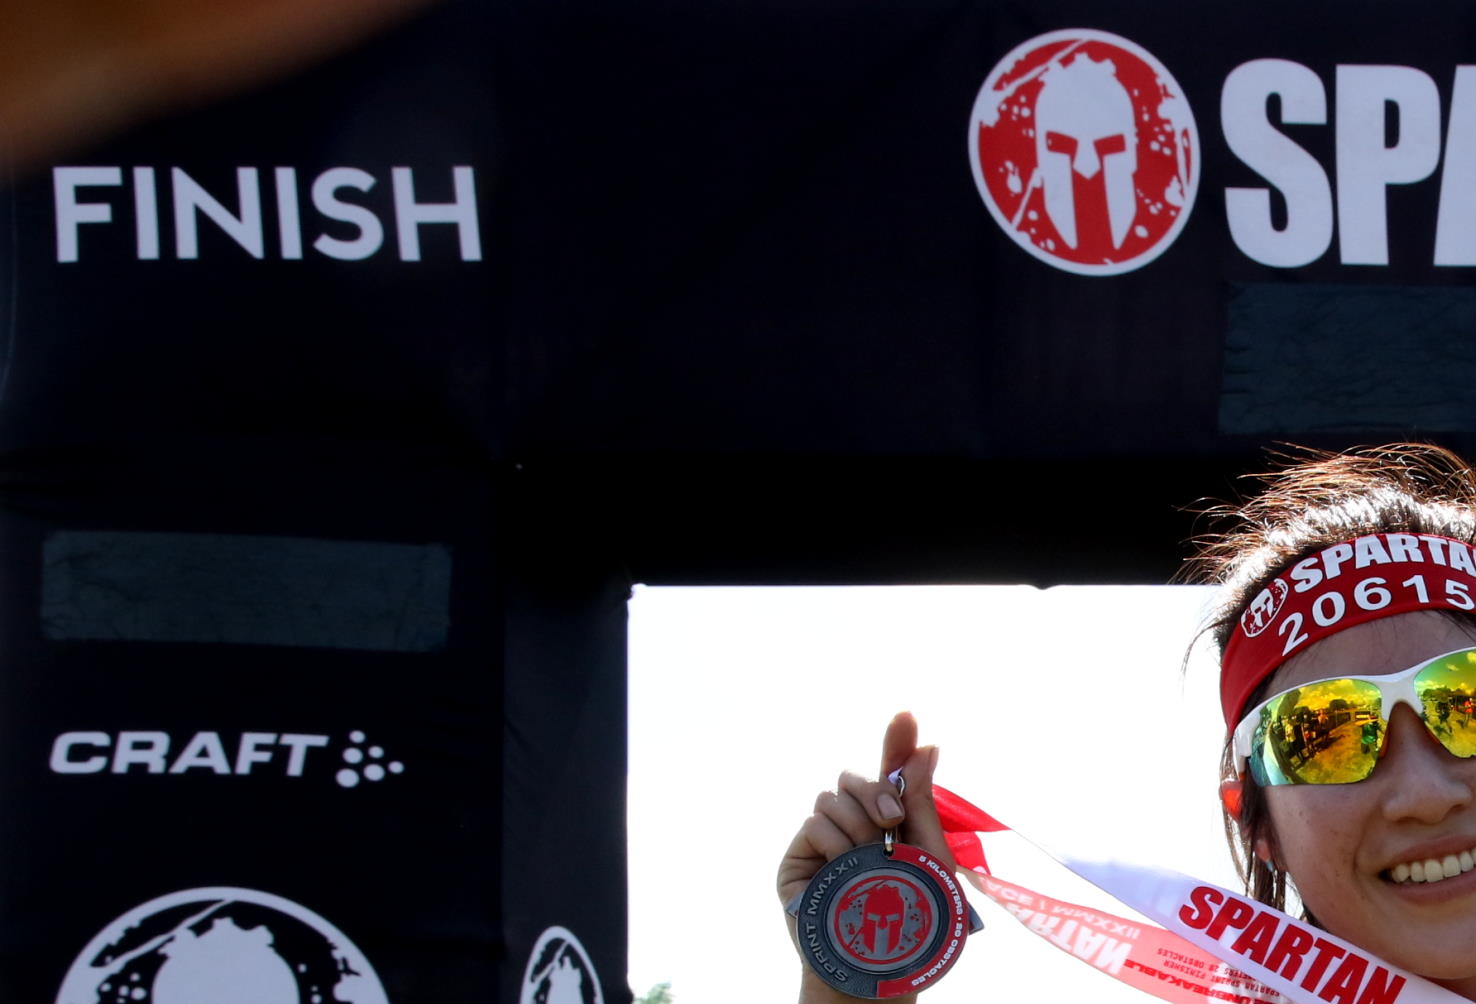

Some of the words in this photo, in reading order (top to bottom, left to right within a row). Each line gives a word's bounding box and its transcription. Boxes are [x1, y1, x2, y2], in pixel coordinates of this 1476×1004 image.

[54, 167, 481, 262] FINISH
[1278, 574, 1475, 656] 20615
[50, 732, 328, 776] CRAFT
[808, 857, 858, 915] MMXXII
[927, 860, 963, 915] KILOMETERS
[806, 923, 848, 983] SPRINT
[911, 939, 958, 986] OBSTACLES
[1157, 948, 1205, 969] OBSTACLES
[1164, 960, 1206, 980] FINISHER
